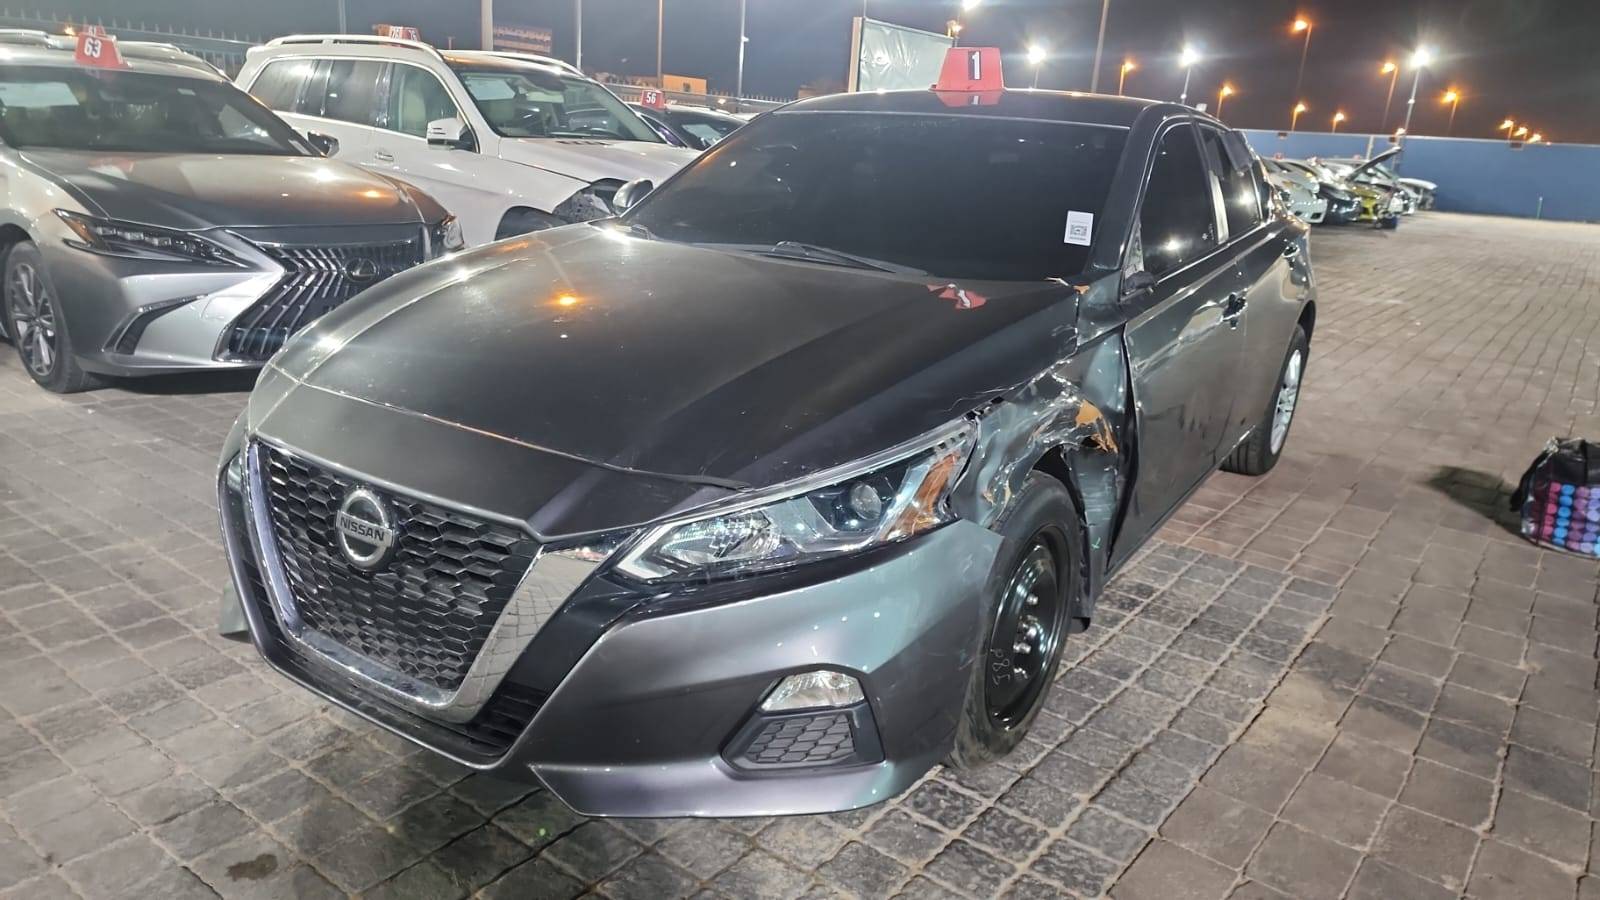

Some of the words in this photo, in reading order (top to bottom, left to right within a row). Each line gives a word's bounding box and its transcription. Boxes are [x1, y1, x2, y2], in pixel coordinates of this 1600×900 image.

[84, 37, 102, 58] 63
[971, 51, 981, 80] 1
[646, 91, 657, 105] 56
[340, 516, 385, 542] NISSAN
